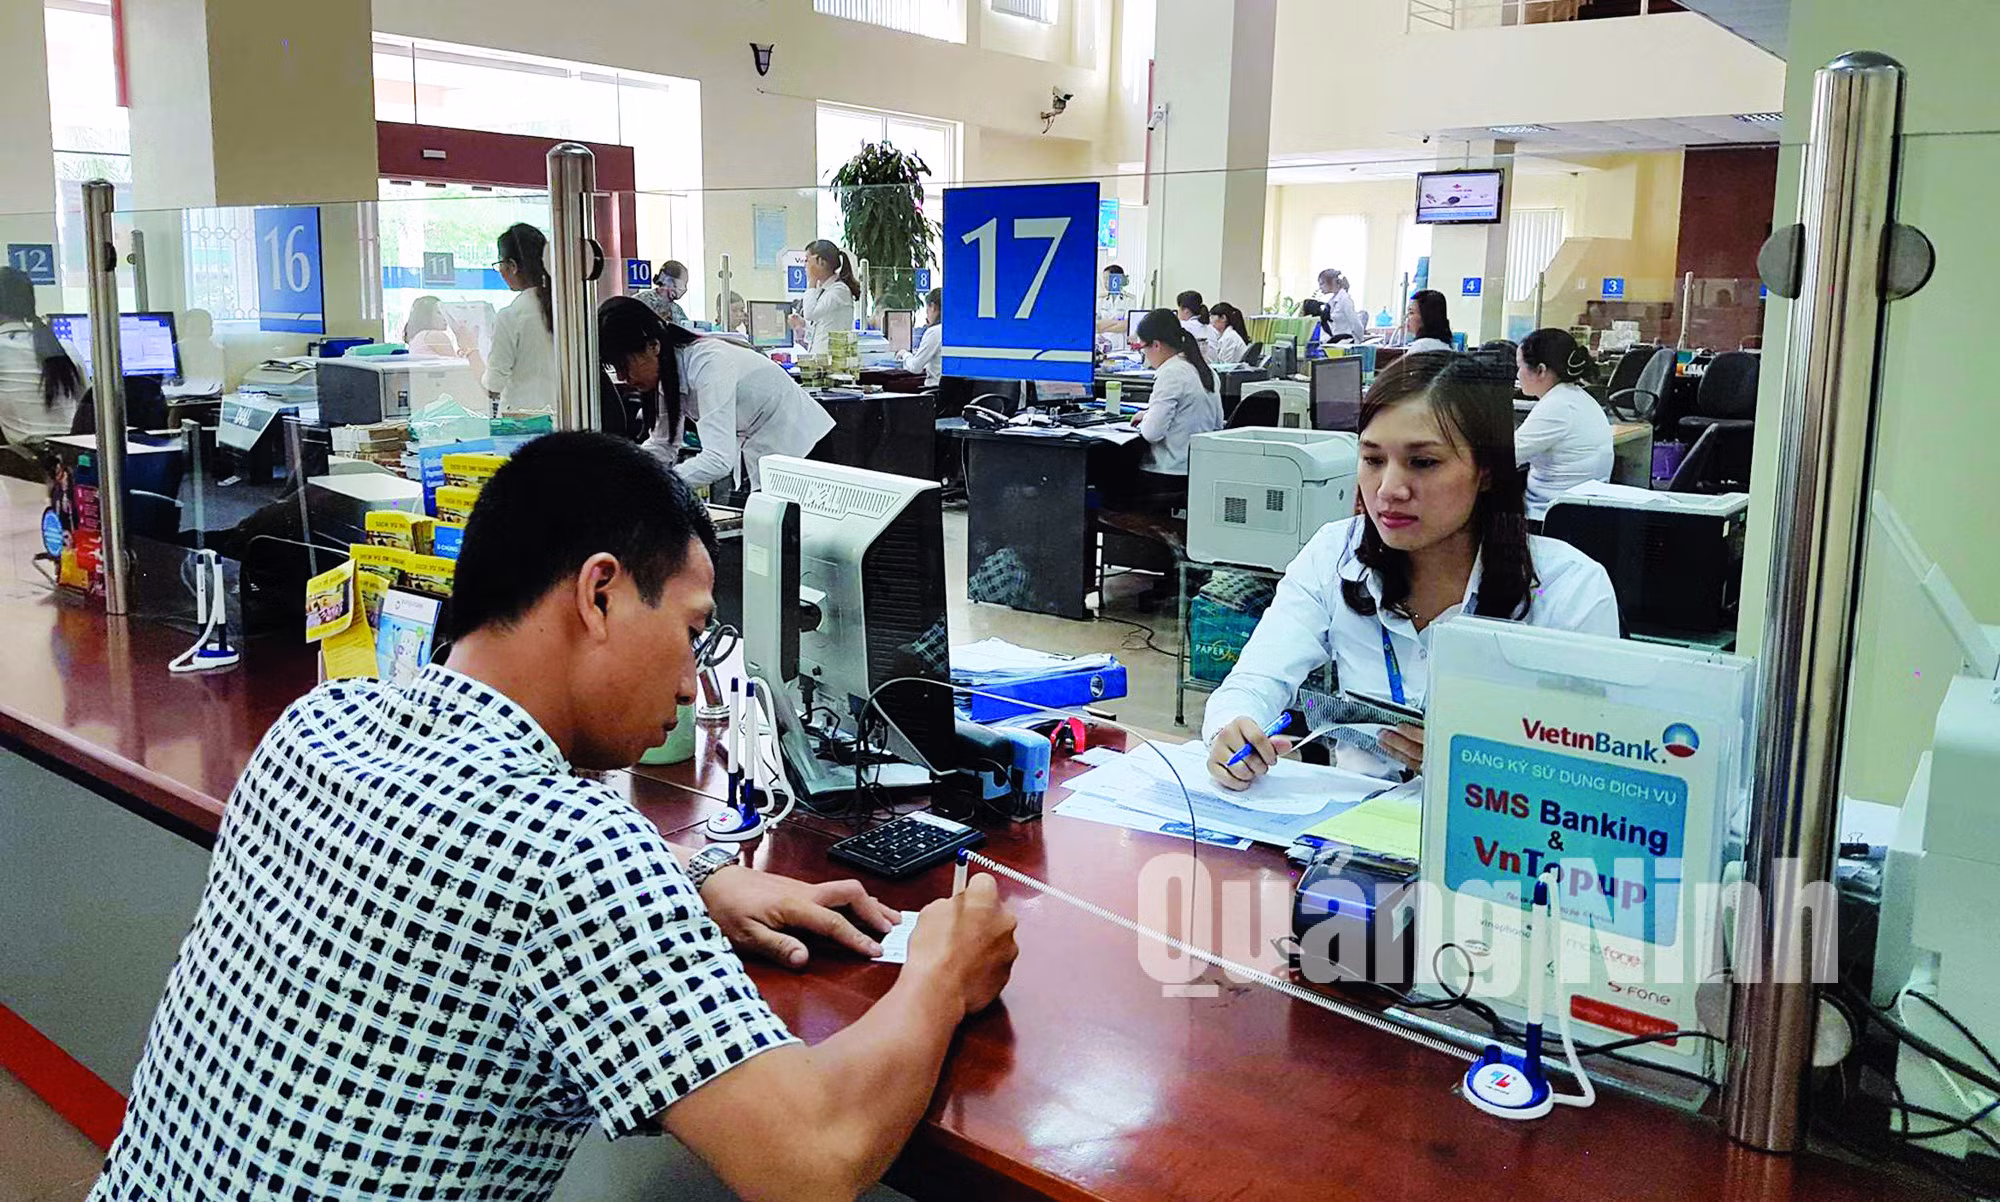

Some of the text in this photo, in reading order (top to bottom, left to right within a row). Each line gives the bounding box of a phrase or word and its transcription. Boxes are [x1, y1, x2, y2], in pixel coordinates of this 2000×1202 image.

[13, 249, 49, 273] 12
[264, 224, 312, 293] 16
[427, 256, 449, 276] 11
[961, 216, 1072, 320] 17
[630, 262, 651, 282] 10
[793, 268, 803, 286] 9
[919, 272, 928, 288] 8
[1111, 276, 1118, 289] 6
[1465, 279, 1476, 292] 4
[1608, 280, 1618, 293] 3
[1195, 643, 1225, 657] PAPER
[1461, 748, 1505, 770] ĐĂNG
[1507, 759, 1529, 775] KÝ
[1559, 770, 1606, 793] DỤNG
[1609, 779, 1650, 801] DỊCH
[1652, 788, 1678, 806] VỤ
[1464, 783, 1669, 857] SMS Banking
[1547, 830, 1565, 852] &
[1473, 835, 1648, 910] VnTopup
